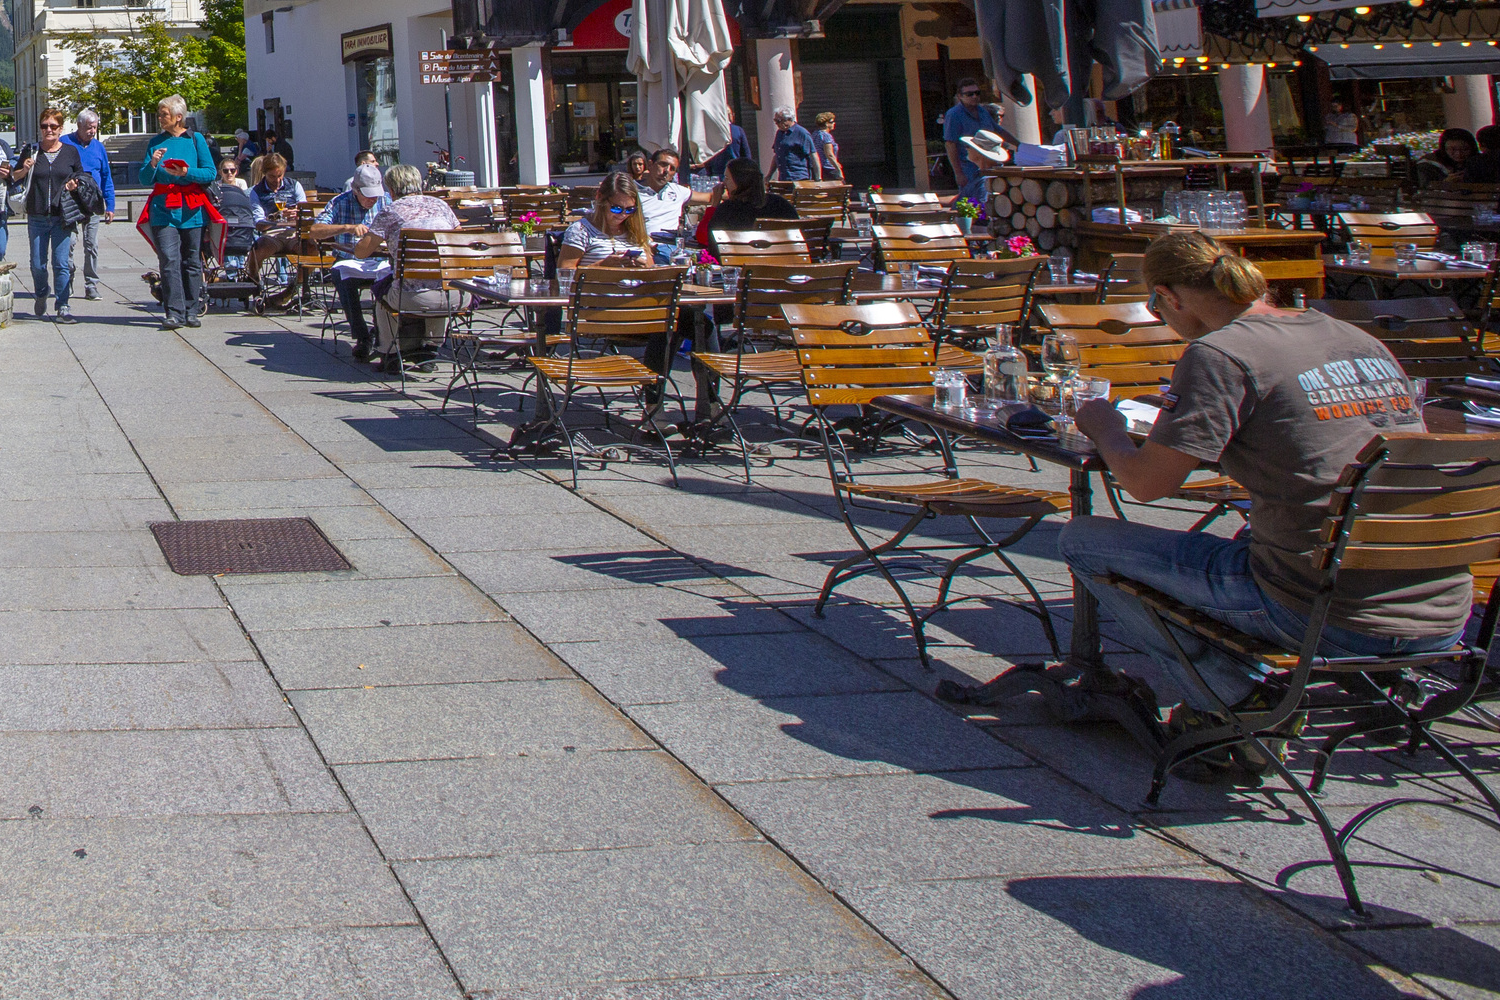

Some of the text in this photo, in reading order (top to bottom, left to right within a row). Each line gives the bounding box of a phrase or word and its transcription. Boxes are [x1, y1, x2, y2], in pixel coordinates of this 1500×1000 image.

[344, 33, 388, 50] TARA IMMOBILIER
[429, 51, 444, 60] Salle
[432, 63, 448, 72] Place
[456, 75, 471, 83] Alpin
[1297, 367, 1331, 392] ONE
[1323, 360, 1360, 387] STEP
[1313, 398, 1388, 421] WORKING
